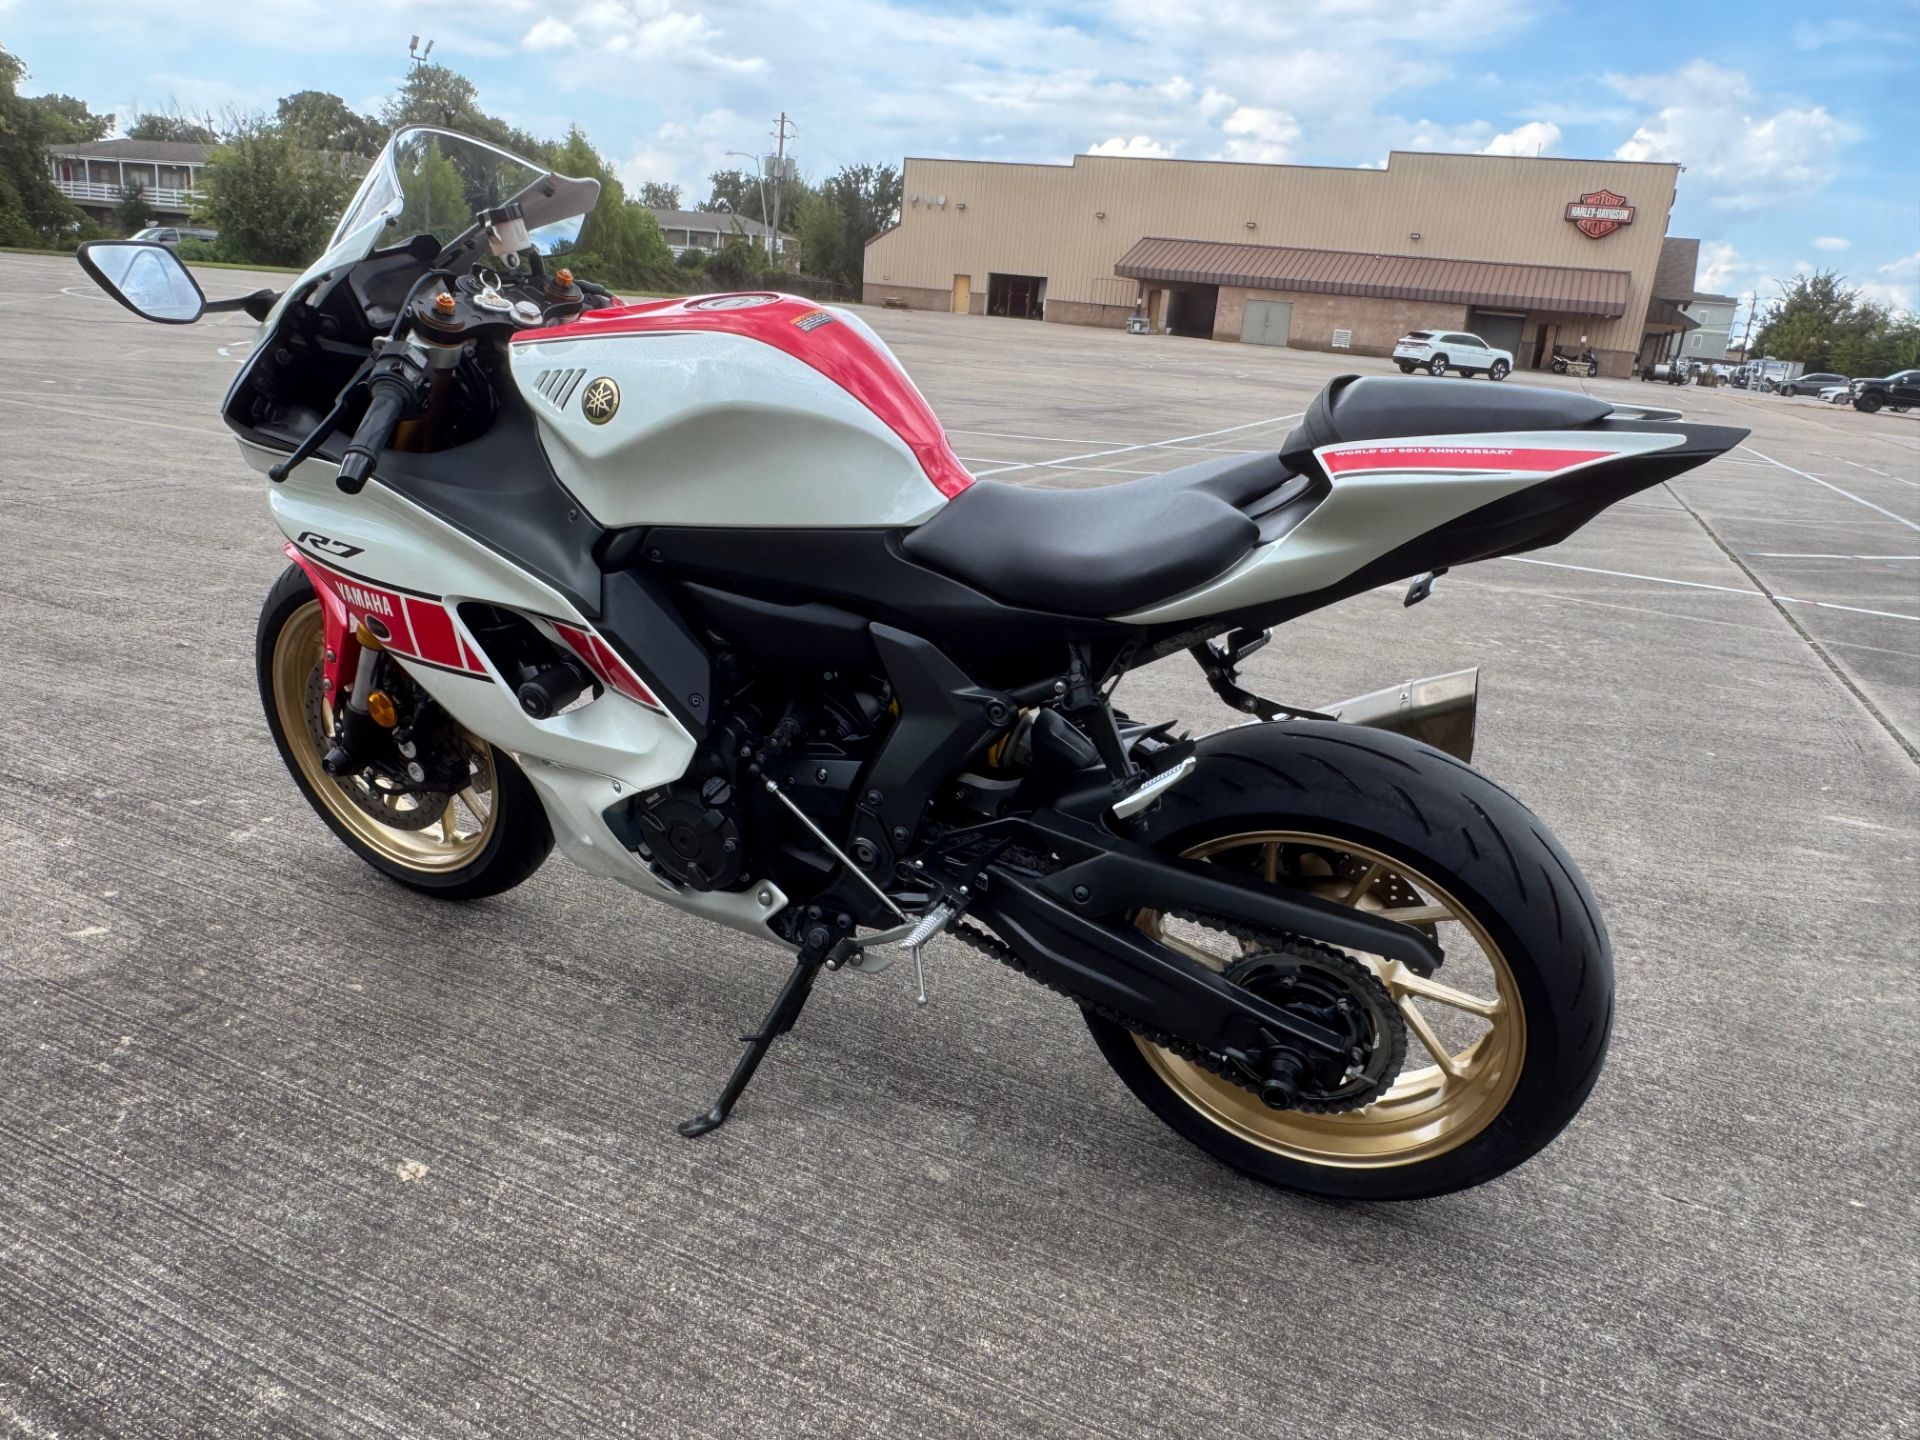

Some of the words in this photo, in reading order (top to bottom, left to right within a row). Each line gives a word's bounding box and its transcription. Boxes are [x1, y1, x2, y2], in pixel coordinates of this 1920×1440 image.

[1586, 195, 1618, 206] MOTOR
[1571, 206, 1629, 220] HARLEY-DAVIDSON
[1581, 220, 1613, 234] CYCLES
[1334, 448, 1377, 456] WORLD
[1428, 447, 1513, 455] ANNIVERSARY
[297, 531, 366, 558] R7
[334, 580, 394, 617] YAMAHA
